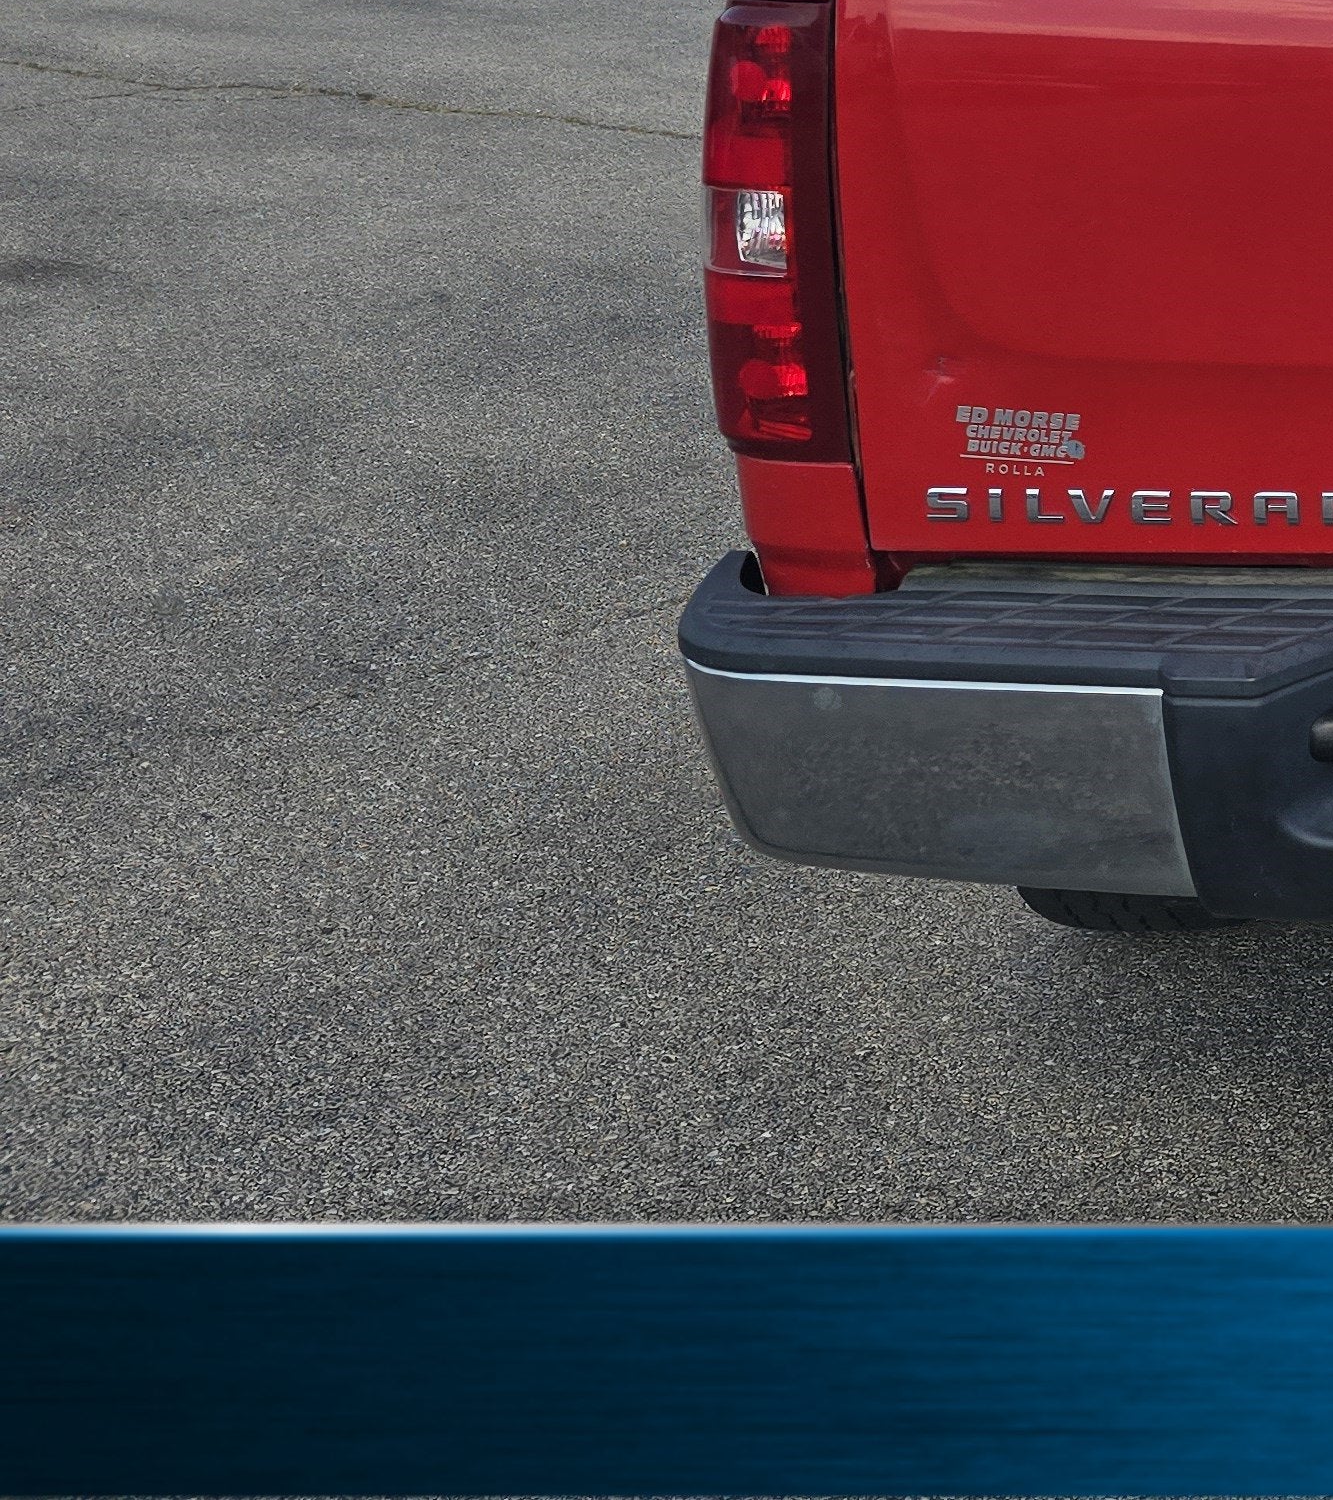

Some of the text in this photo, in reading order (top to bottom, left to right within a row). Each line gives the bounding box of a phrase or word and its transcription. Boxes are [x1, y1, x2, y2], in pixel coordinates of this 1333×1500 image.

[956, 405, 1080, 430] ED MORSE
[966, 424, 1072, 444] CHEVROLET
[986, 463, 1045, 477] ROLLA
